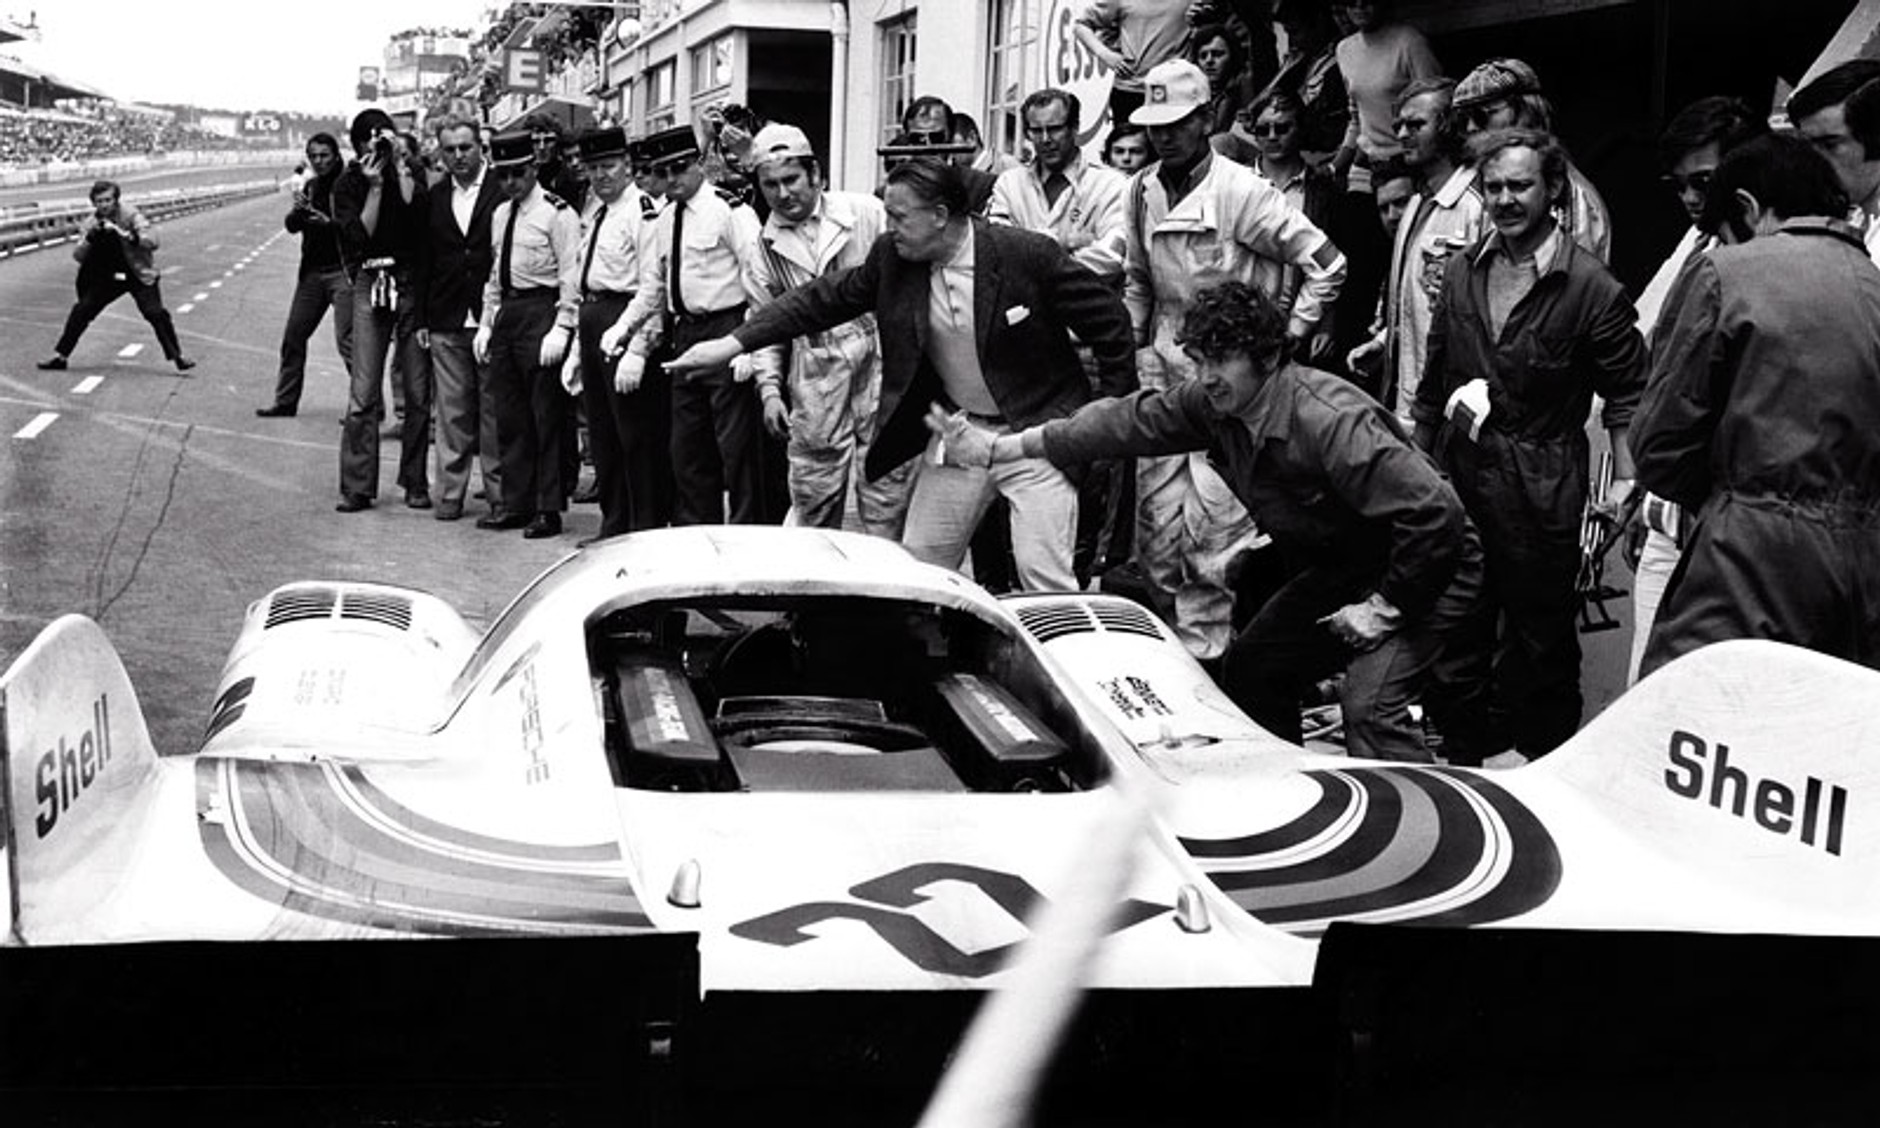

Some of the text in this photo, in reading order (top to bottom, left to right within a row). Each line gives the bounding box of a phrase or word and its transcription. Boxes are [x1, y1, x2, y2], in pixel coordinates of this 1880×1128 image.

[509, 50, 540, 86] E
[35, 692, 112, 840] Shell
[1664, 729, 1848, 858] Shell
